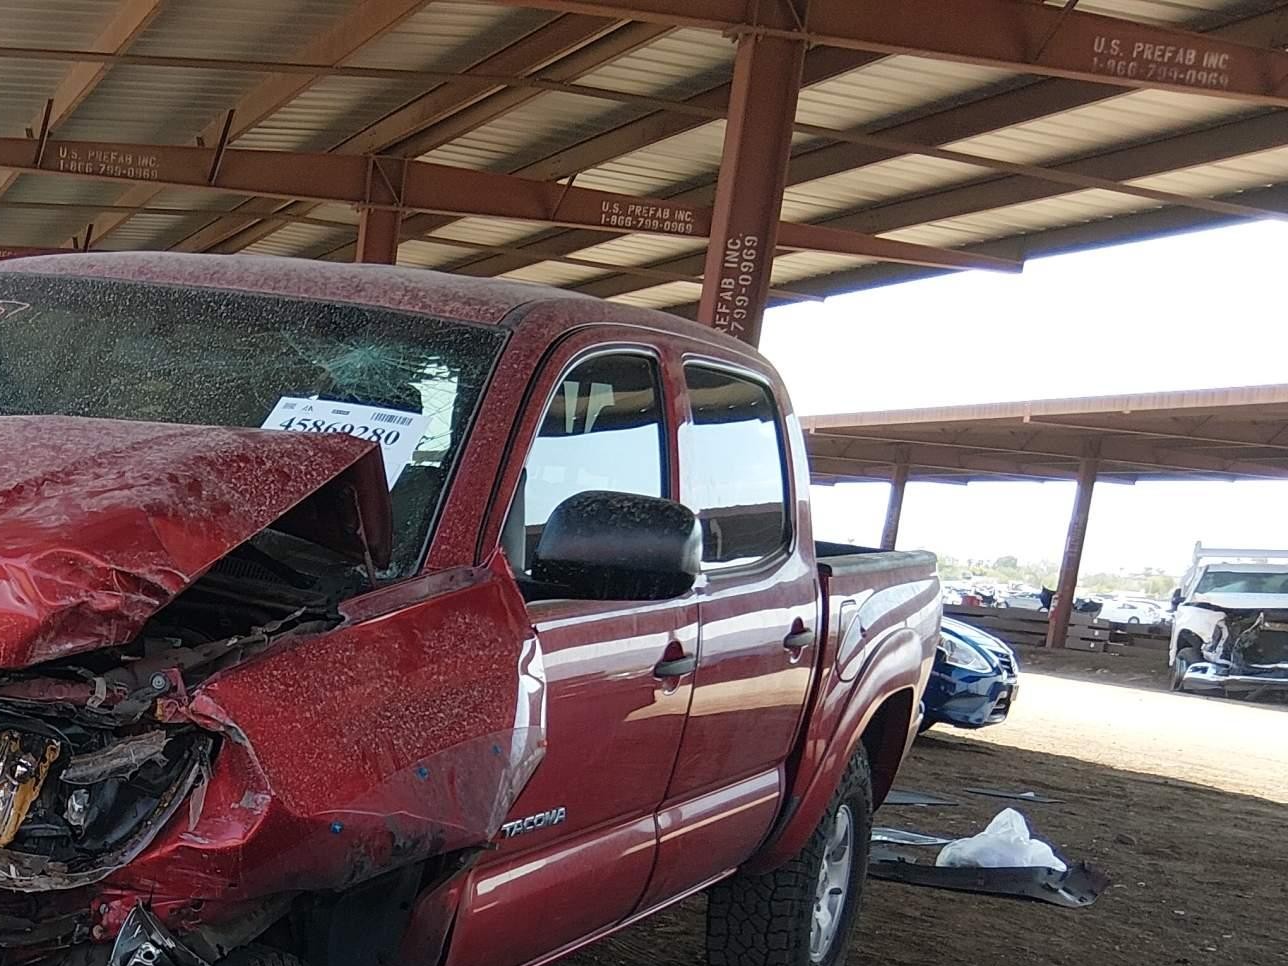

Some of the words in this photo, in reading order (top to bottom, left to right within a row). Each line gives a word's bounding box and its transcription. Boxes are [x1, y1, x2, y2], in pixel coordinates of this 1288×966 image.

[1093, 35, 1123, 57] U.S.
[1132, 42, 1197, 66] PREFAB
[59, 159, 159, 180] 1-866799-0969
[88, 150, 134, 165] PREFAB
[601, 200, 623, 215] U.S.
[627, 204, 671, 220] PREFAB
[675, 209, 695, 223] INC.
[601, 213, 694, 234] 1-866-799-0969
[723, 232, 743, 269] INC.
[713, 277, 736, 334] REFAB
[279, 416, 401, 446] 45869280
[501, 806, 567, 838] TACOMA
